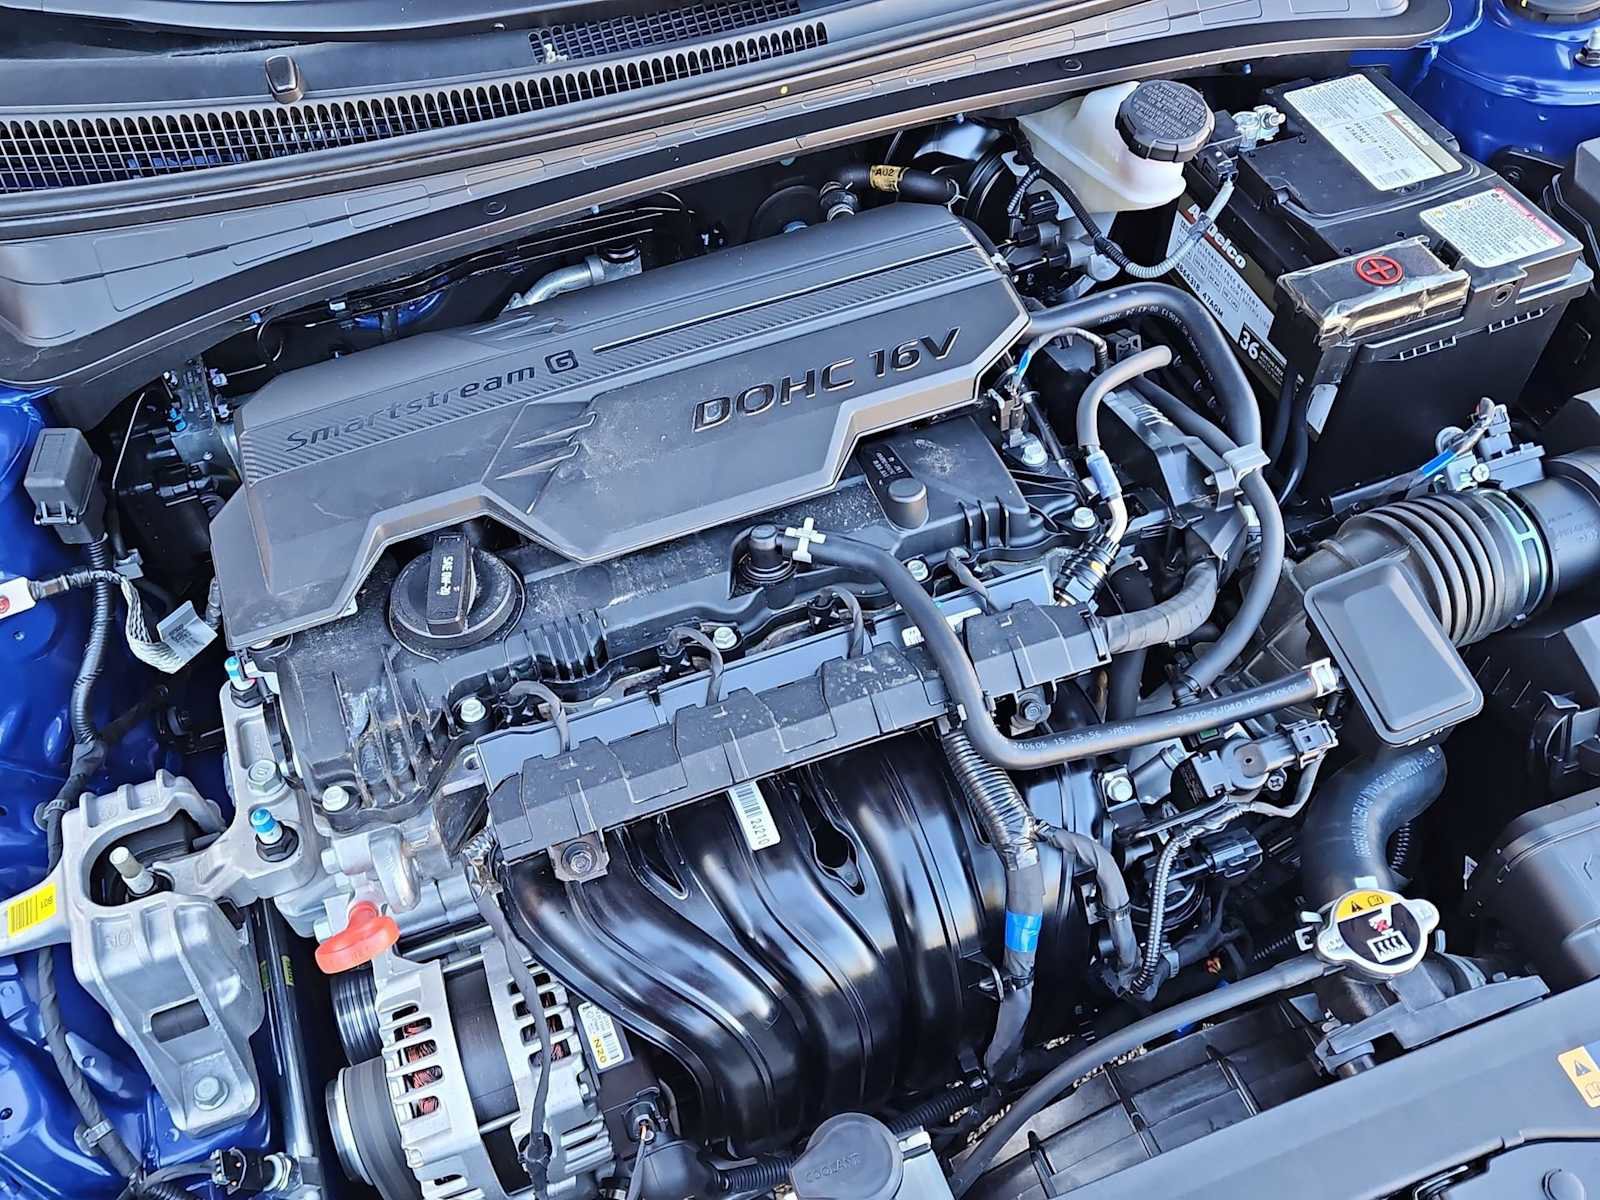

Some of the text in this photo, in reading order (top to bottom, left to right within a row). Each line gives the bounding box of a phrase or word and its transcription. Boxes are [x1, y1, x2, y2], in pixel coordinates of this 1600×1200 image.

[1187, 203, 1246, 269] ADelco
[1202, 291, 1224, 318] 47AGM
[1240, 330, 1260, 361] 36
[692, 327, 961, 433] DOHC 16V
[286, 349, 579, 452] Smartstream G
[442, 556, 453, 571] SAE
[594, 1038, 607, 1063] N20
